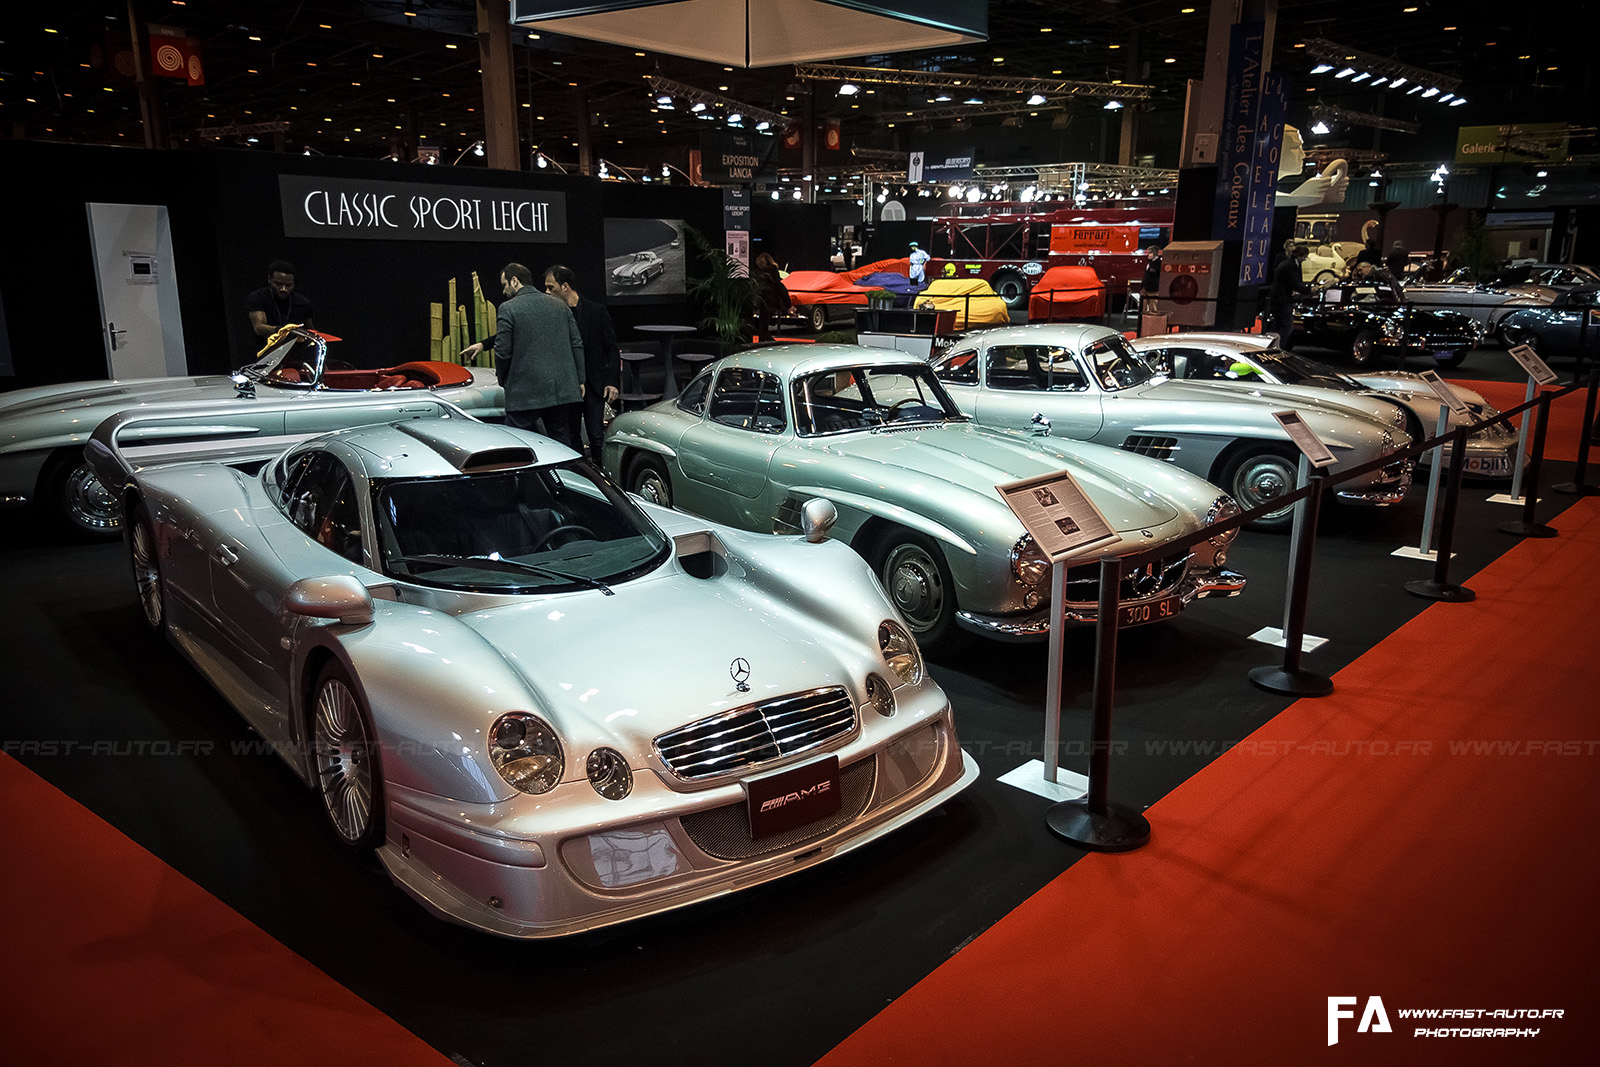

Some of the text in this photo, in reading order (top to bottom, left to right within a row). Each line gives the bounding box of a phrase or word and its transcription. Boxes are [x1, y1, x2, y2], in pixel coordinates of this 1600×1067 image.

[1236, 124, 1254, 153] des
[1461, 142, 1496, 154] Galerie
[722, 154, 759, 167] EXPOSITION
[729, 167, 753, 179] LANCIA
[1227, 162, 1249, 229] Coteaux
[303, 190, 550, 232] CLASSIC SPORT LEICHT
[1073, 229, 1111, 240] Ferrari
[1126, 600, 1173, 624] 300 SL
